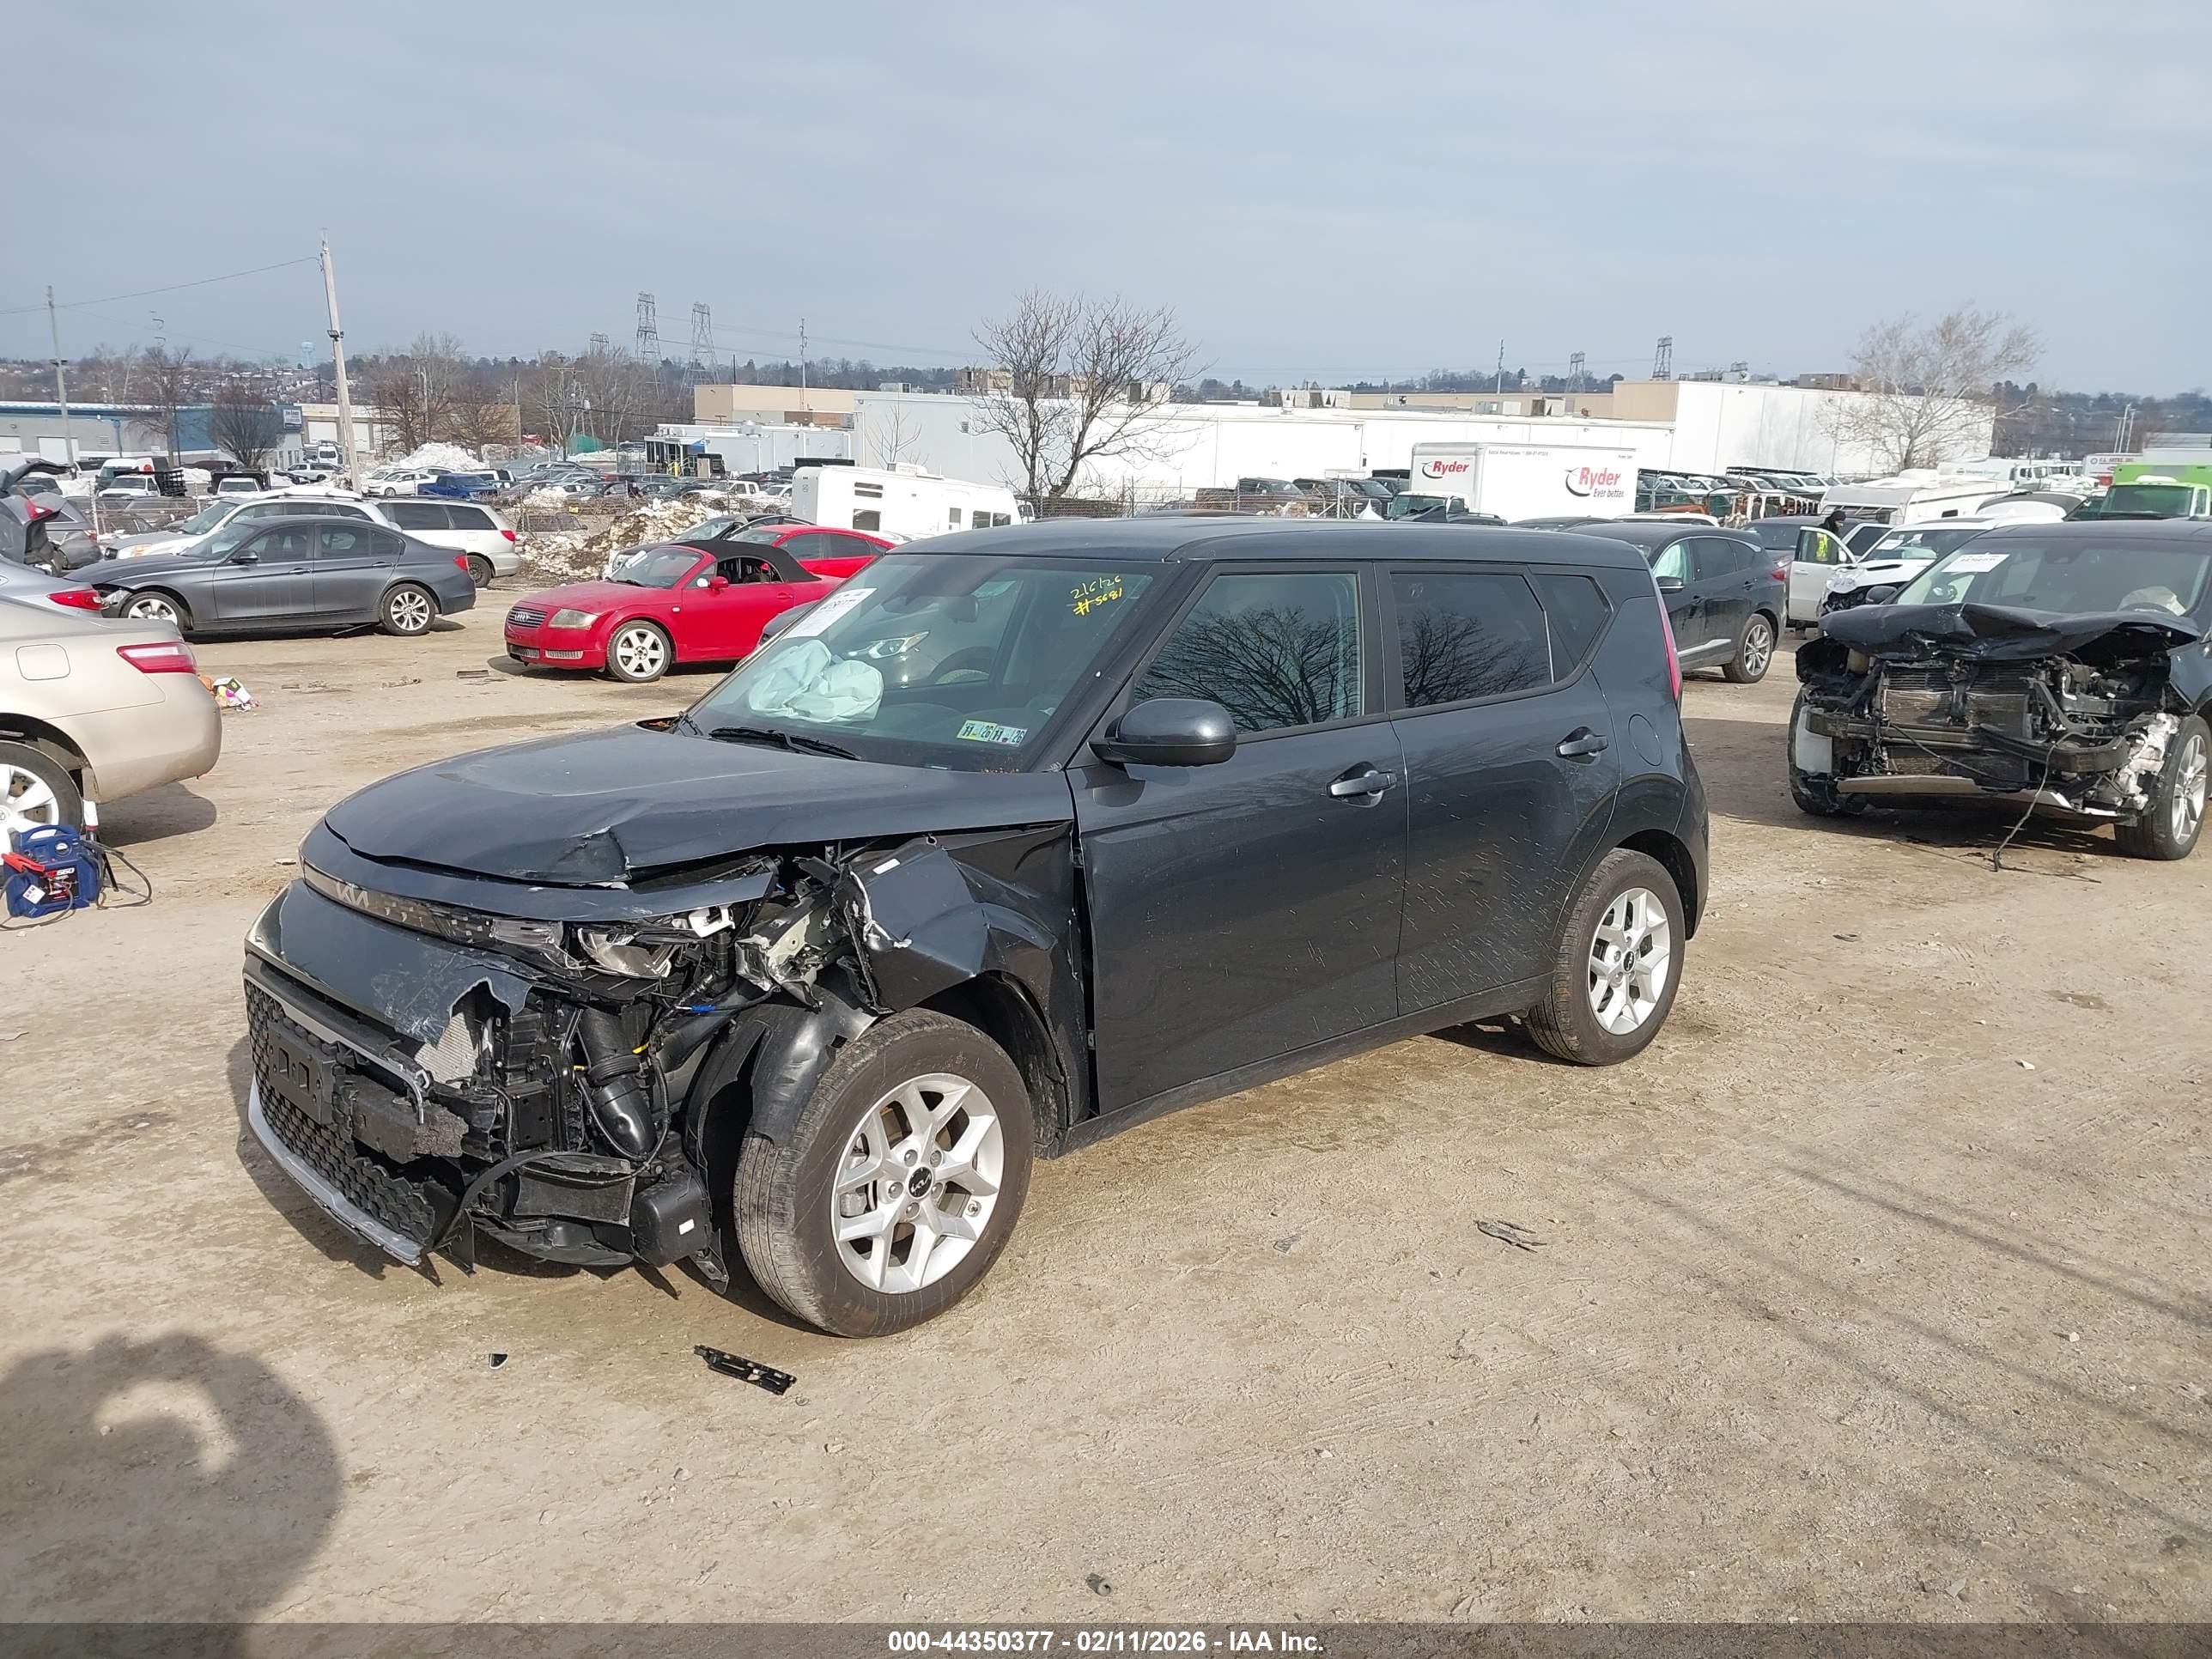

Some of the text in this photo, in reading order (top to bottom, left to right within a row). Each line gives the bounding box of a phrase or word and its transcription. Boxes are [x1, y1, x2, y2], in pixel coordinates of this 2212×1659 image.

[1432, 460, 1469, 475] Ryder
[1579, 466, 1621, 489] Ryder
[1593, 488, 1606, 498] Ever
